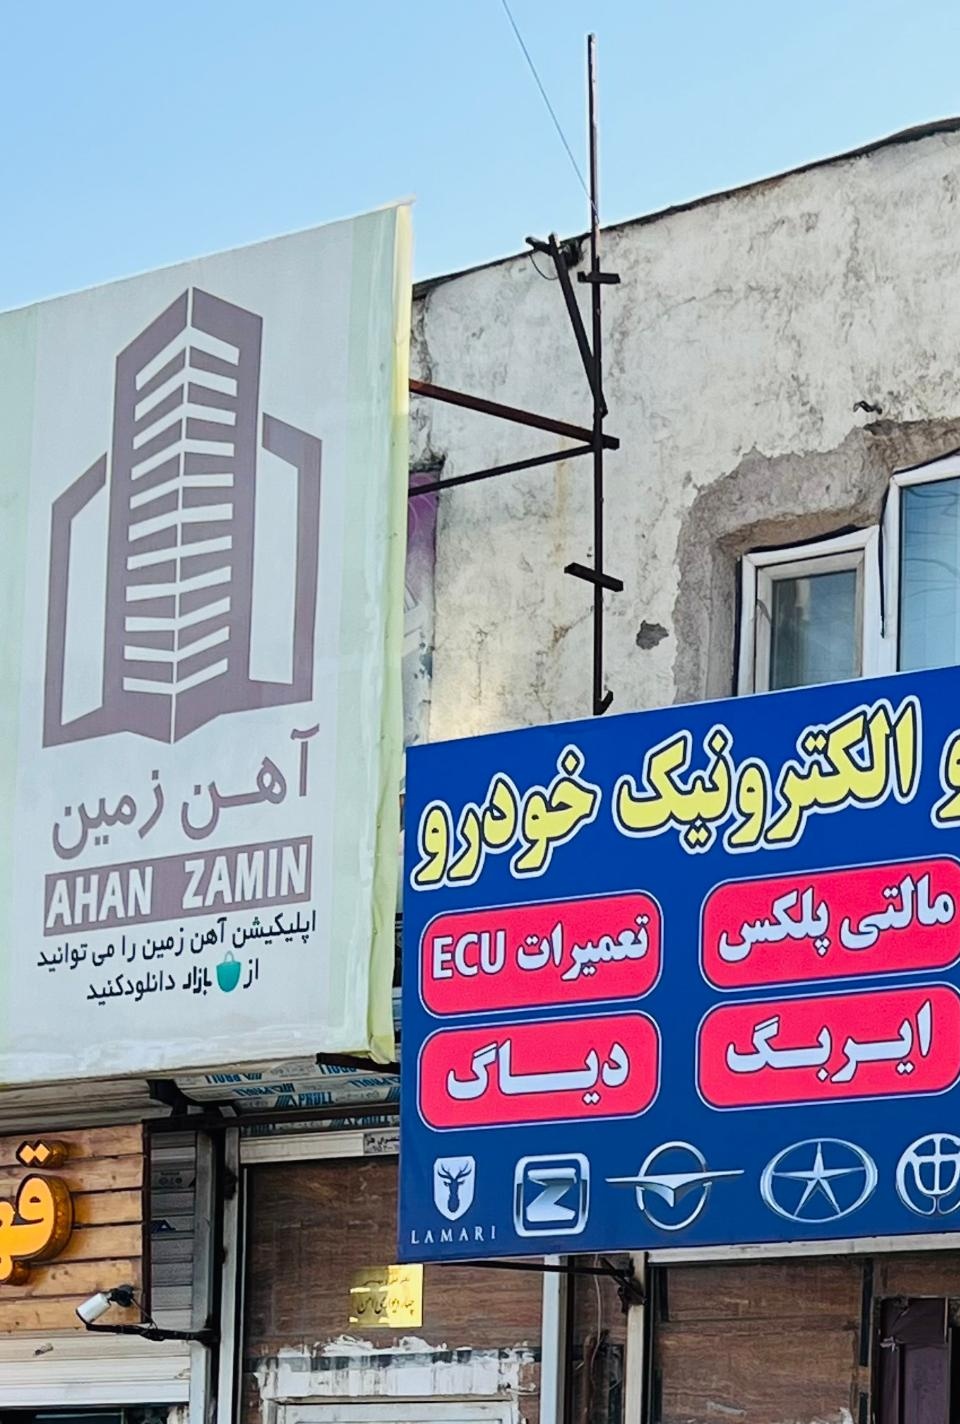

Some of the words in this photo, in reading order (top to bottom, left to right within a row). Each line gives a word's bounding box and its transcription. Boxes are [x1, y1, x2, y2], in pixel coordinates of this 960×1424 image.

[181, 723, 320, 840] آهن
[613, 695, 922, 854] الکترونیک
[52, 768, 164, 861] زمین
[411, 745, 601, 891] خودرو
[45, 866, 154, 929] AHAN
[182, 843, 308, 911] ZAMIN
[839, 873, 957, 950] مالتی
[122, 935, 137, 962] را
[142, 927, 184, 960] زمین
[190, 917, 228, 953] آهن
[232, 910, 316, 948] اپلیکیشن
[516, 914, 651, 981] تعمیرات
[718, 886, 829, 956] پلکس
[243, 958, 259, 988] از
[432, 931, 506, 981] ECU
[446, 1041, 630, 1104] دیاگ
[726, 1000, 933, 1085] ایربگ
[410, 1225, 497, 1246] LAMARI
